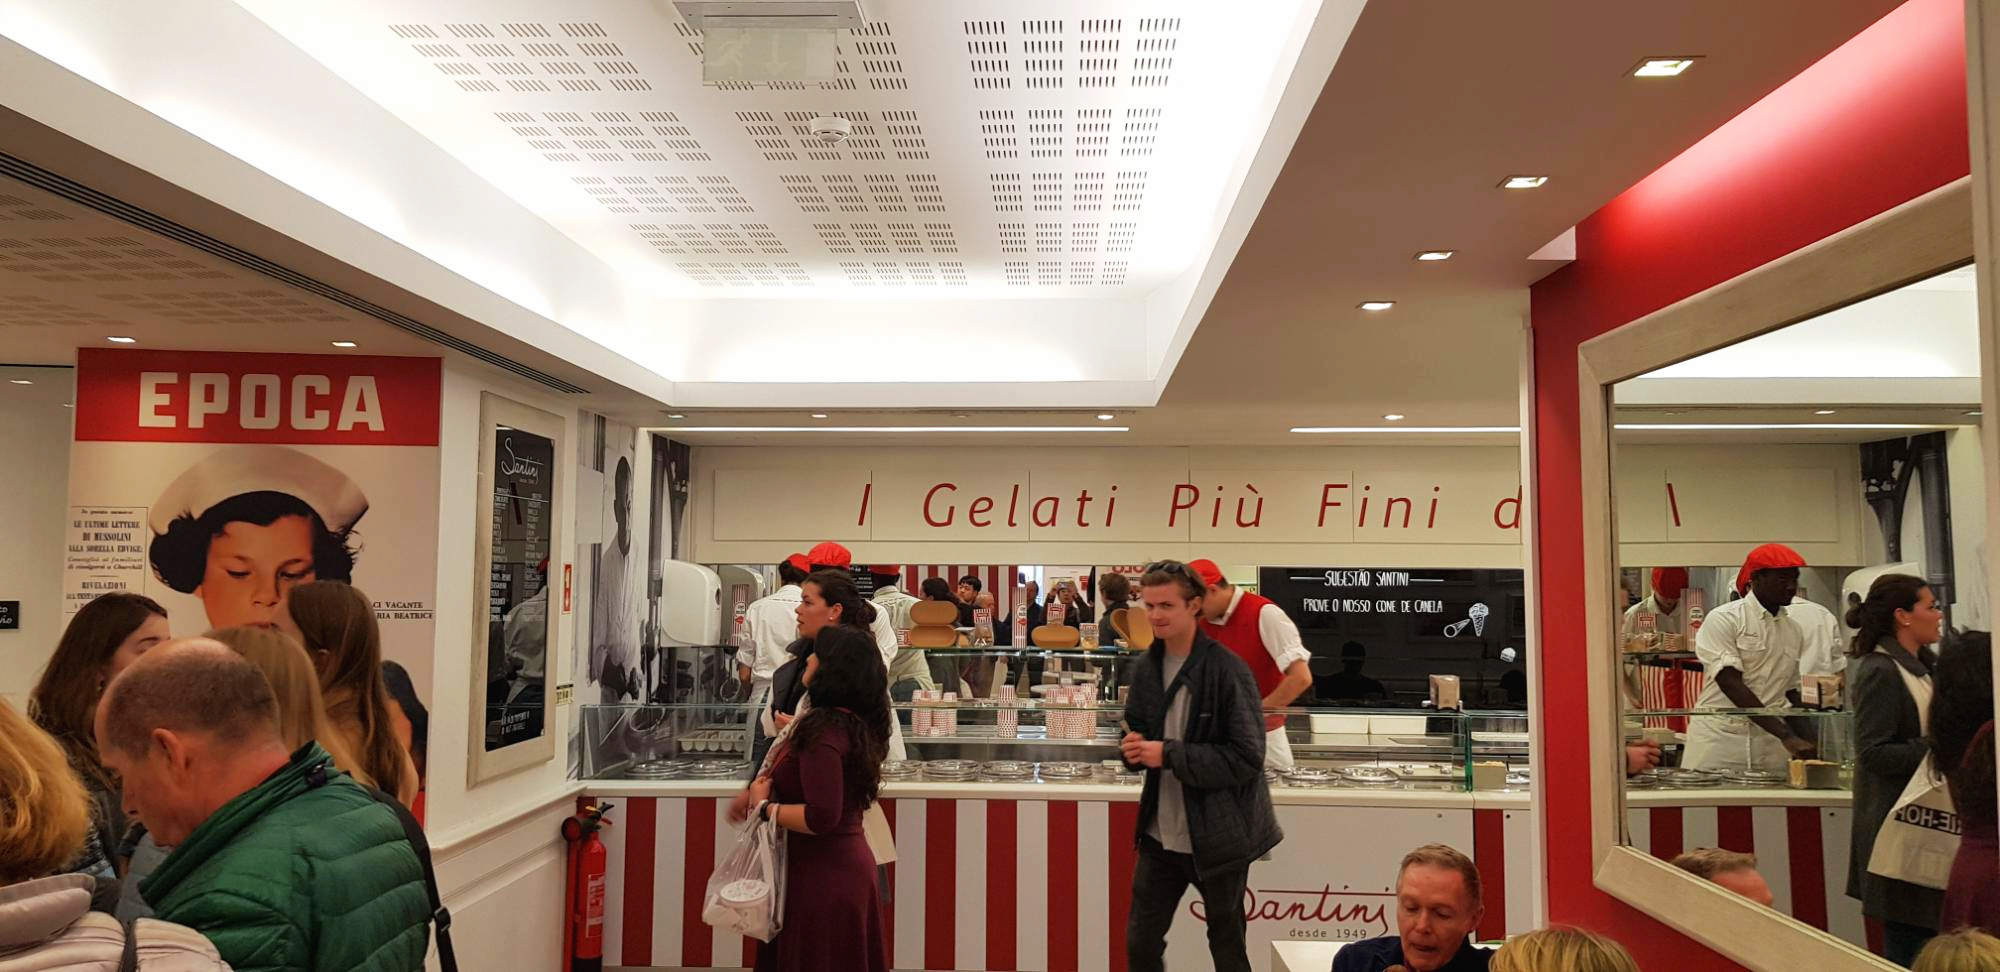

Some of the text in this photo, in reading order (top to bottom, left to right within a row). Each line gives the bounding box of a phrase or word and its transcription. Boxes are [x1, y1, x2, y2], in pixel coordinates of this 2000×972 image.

[138, 371, 385, 431] EPOCA
[501, 437, 544, 484] Santini
[858, 483, 871, 526] I
[923, 483, 1118, 528] Gelati
[1168, 483, 1264, 528] Più
[1317, 483, 1440, 528] Fini
[1323, 569, 1409, 587] SUGESTÃO SANTINI
[1303, 598, 1443, 613] PROVE O NOSSO CONE DE CANELA
[1289, 928, 1367, 938] desde 1949
